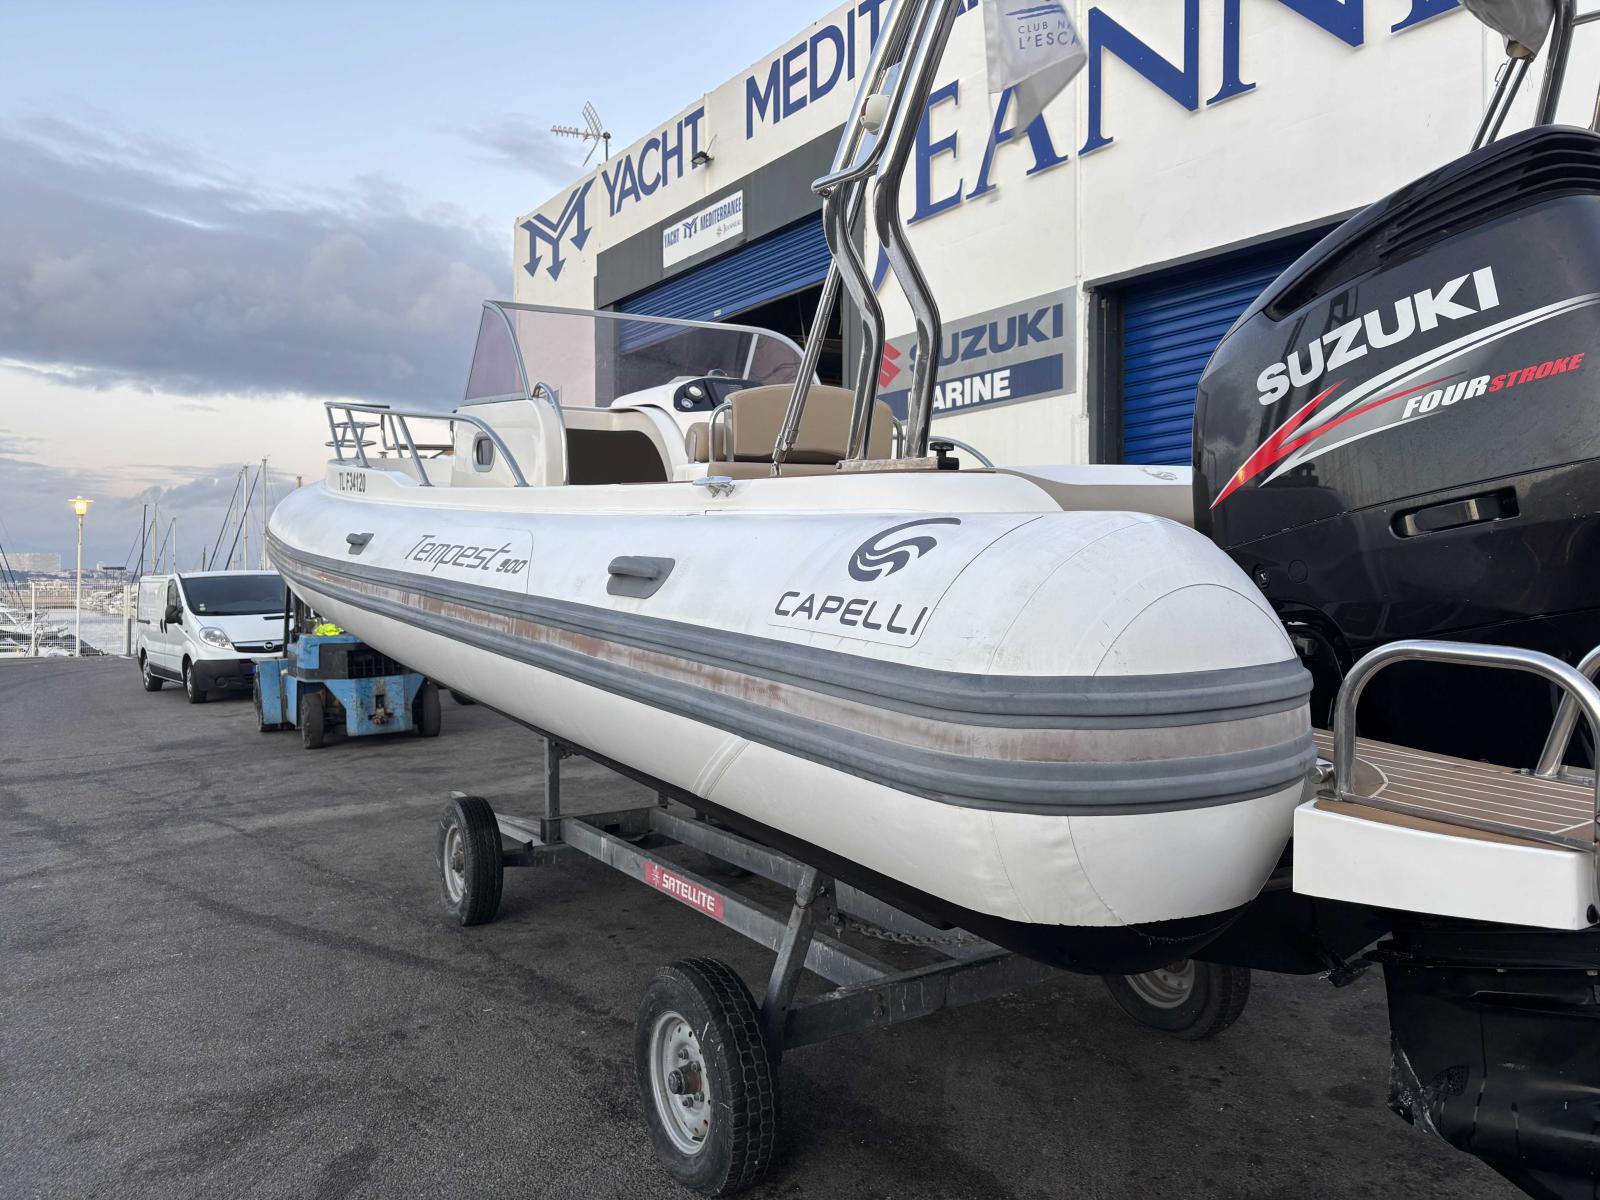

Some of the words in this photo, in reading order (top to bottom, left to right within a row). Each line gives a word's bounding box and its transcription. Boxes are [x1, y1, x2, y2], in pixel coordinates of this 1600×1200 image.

[1018, 21, 1049, 34] CLUB
[602, 106, 704, 216] YACHT
[664, 228, 680, 249] YACHT
[700, 196, 742, 231] MEDITERRANEE
[1256, 265, 1500, 406] SUZUKI
[907, 368, 1011, 414] ARINE
[404, 534, 512, 572] Tempest
[774, 591, 929, 636] CAPELLI
[662, 873, 715, 913] SATELLITE
